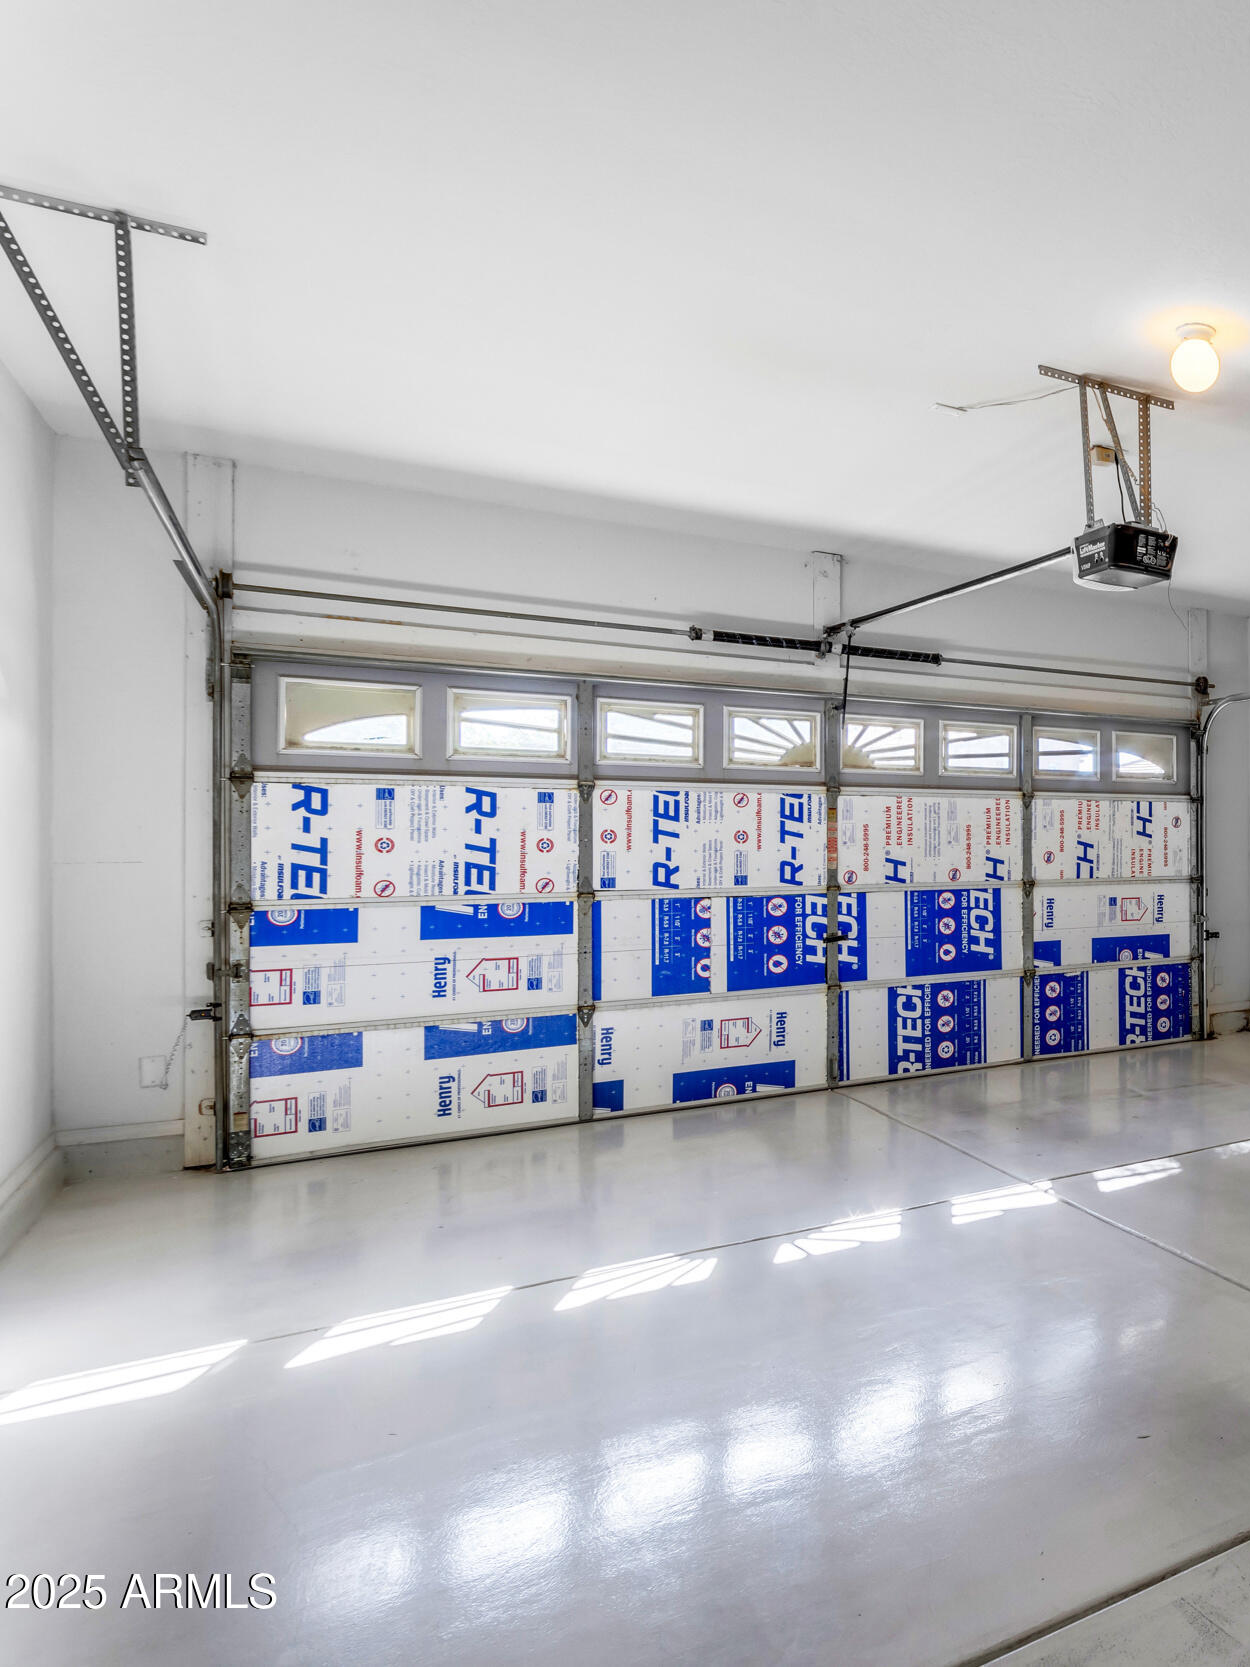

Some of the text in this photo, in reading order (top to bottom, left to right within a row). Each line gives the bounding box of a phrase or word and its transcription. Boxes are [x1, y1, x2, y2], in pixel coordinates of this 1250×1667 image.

[884, 857, 907, 884] H
[985, 855, 1005, 881] H
[478, 904, 488, 919] EN
[961, 891, 969, 954] FOR EFFICIENCY
[1044, 897, 1056, 929] Henry
[1155, 894, 1165, 923] Henry
[795, 896, 803, 965] FOR EFFICIENCY
[837, 893, 858, 963] ECH
[432, 957, 451, 999] Henry
[774, 1011, 788, 1047] Henry
[924, 1018, 932, 1035] FOR
[597, 1027, 614, 1066] Henry
[436, 1075, 456, 1118] Henry
